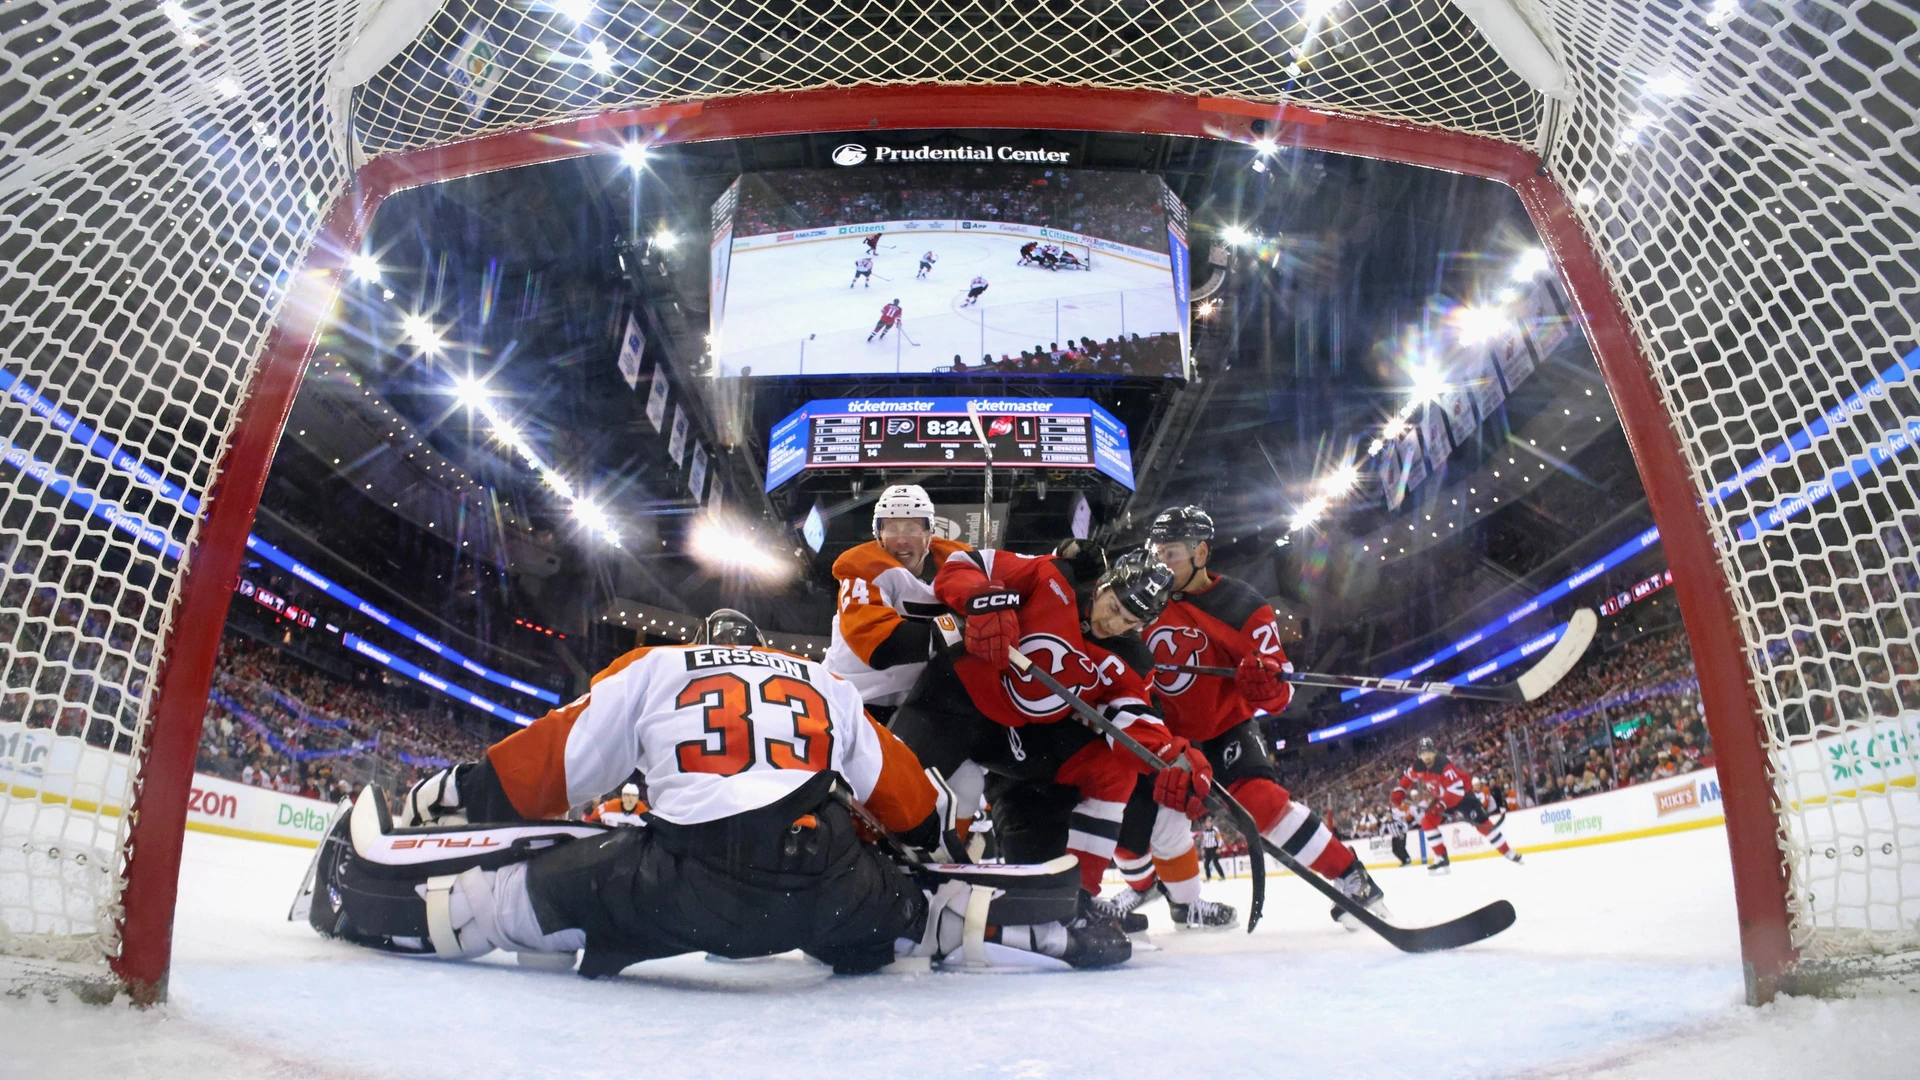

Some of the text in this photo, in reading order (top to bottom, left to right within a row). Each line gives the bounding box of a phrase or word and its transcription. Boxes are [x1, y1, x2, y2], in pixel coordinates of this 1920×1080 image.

[874, 145, 1070, 162] Prudential Center
[848, 224, 885, 234] Citizens
[847, 400, 935, 412] ticketmaster
[973, 400, 1053, 412] icketmaster
[869, 421, 877, 435] 1
[927, 420, 972, 435] 8:24
[1021, 421, 1029, 435] 1
[867, 449, 878, 457] 14
[945, 449, 954, 459] 3
[1023, 449, 1032, 457] 11
[1145, 577, 1161, 596] 13
[840, 577, 869, 613] 24
[973, 594, 1020, 609] CCM
[1130, 594, 1149, 610] CCM
[694, 650, 801, 678] ERSSON
[1098, 655, 1125, 686] C
[1353, 675, 1455, 696] TRUE
[675, 672, 834, 777] 33
[1660, 789, 1693, 809] MIKE'S
[1540, 807, 1572, 825] choose
[1554, 814, 1602, 835] new jersey
[391, 837, 503, 850] TRUE
